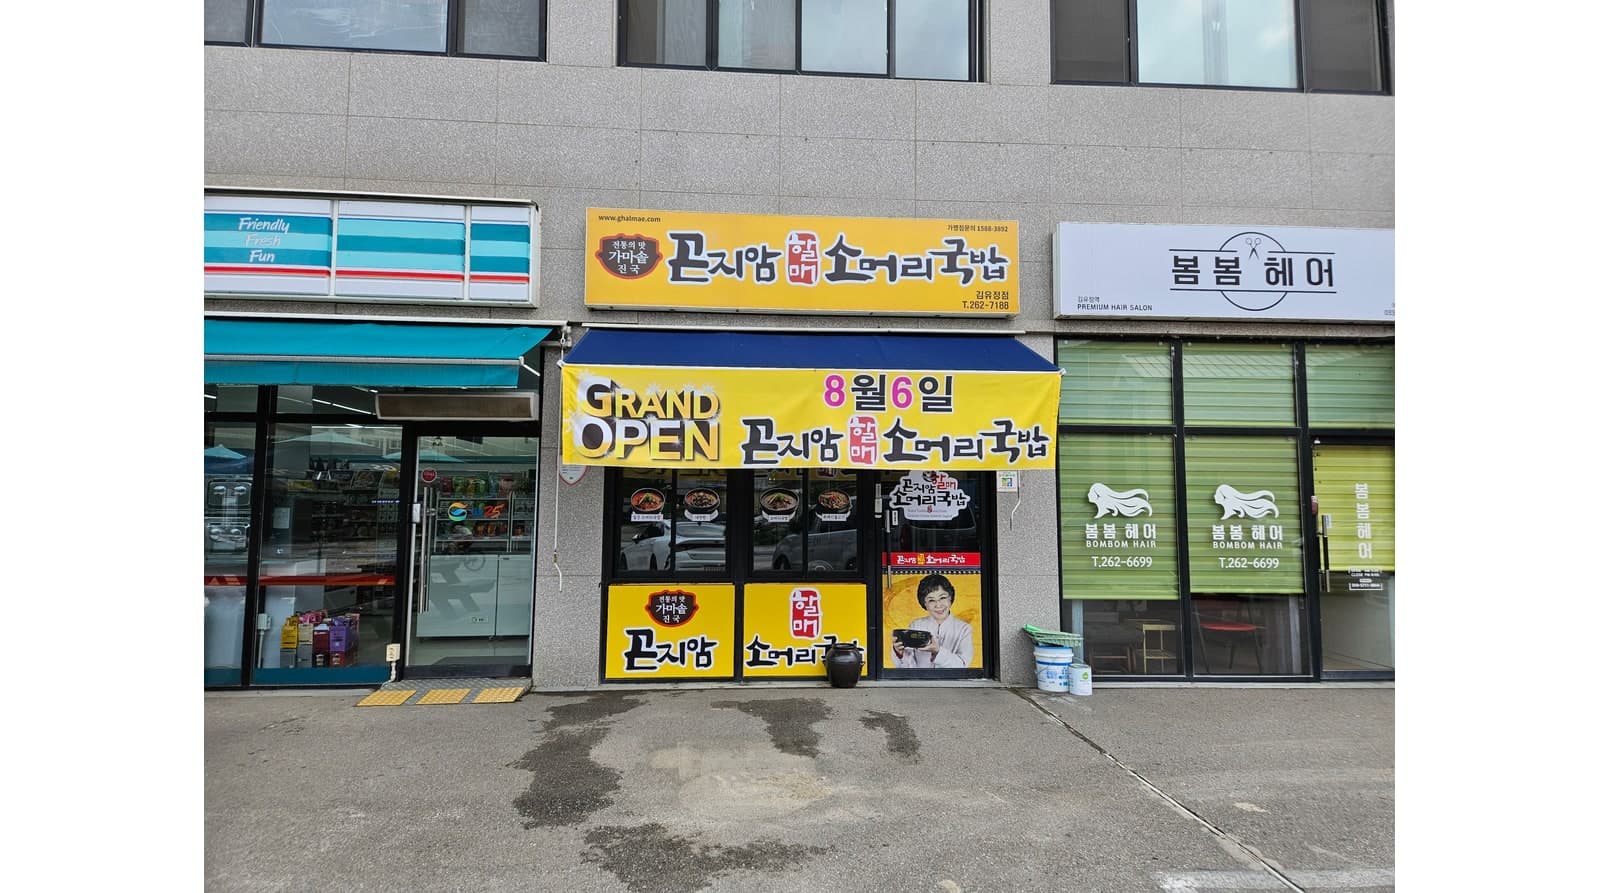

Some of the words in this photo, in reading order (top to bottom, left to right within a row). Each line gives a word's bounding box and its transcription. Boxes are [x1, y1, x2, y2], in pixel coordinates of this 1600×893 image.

[238, 217, 290, 235] Friendly
[598, 214, 661, 223] www.ghalmae.com
[245, 233, 281, 248] Fresh
[612, 240, 635, 249] 전통의
[638, 240, 647, 250] 맛
[249, 249, 275, 263] Fun
[608, 250, 649, 264] 가마솥
[668, 232, 782, 282] 곤지암
[789, 232, 818, 284] 할매
[824, 234, 1009, 285] 소머리국밥
[1171, 255, 1242, 286] 봄봄
[1263, 257, 1334, 287] 헤어
[976, 290, 1009, 300] 김유정점
[962, 300, 1009, 310] T.262-7188
[578, 376, 720, 420] GRAND
[574, 414, 720, 461] OPEN
[741, 418, 844, 465] 곤지암
[850, 416, 877, 464] 할매
[882, 418, 1049, 463] 소머리국밥
[902, 478, 936, 494] 곤지암
[893, 487, 967, 506] 소머리국밥
[1085, 523, 1117, 539] 봄봄
[1125, 523, 1157, 539] 헤어
[1212, 525, 1243, 540] 봄봄
[1251, 525, 1283, 540] 헤어
[1086, 540, 1128, 548] BOMBOM
[1133, 540, 1156, 548] HAIR
[1213, 541, 1255, 549] BOMBOM
[1260, 541, 1283, 549] HAIR
[1091, 556, 1153, 568] T.262-6699
[1218, 557, 1280, 568] T.262-6699
[655, 603, 688, 615] 가마솥
[790, 589, 821, 636] 할매
[624, 628, 717, 671] 곤지암
